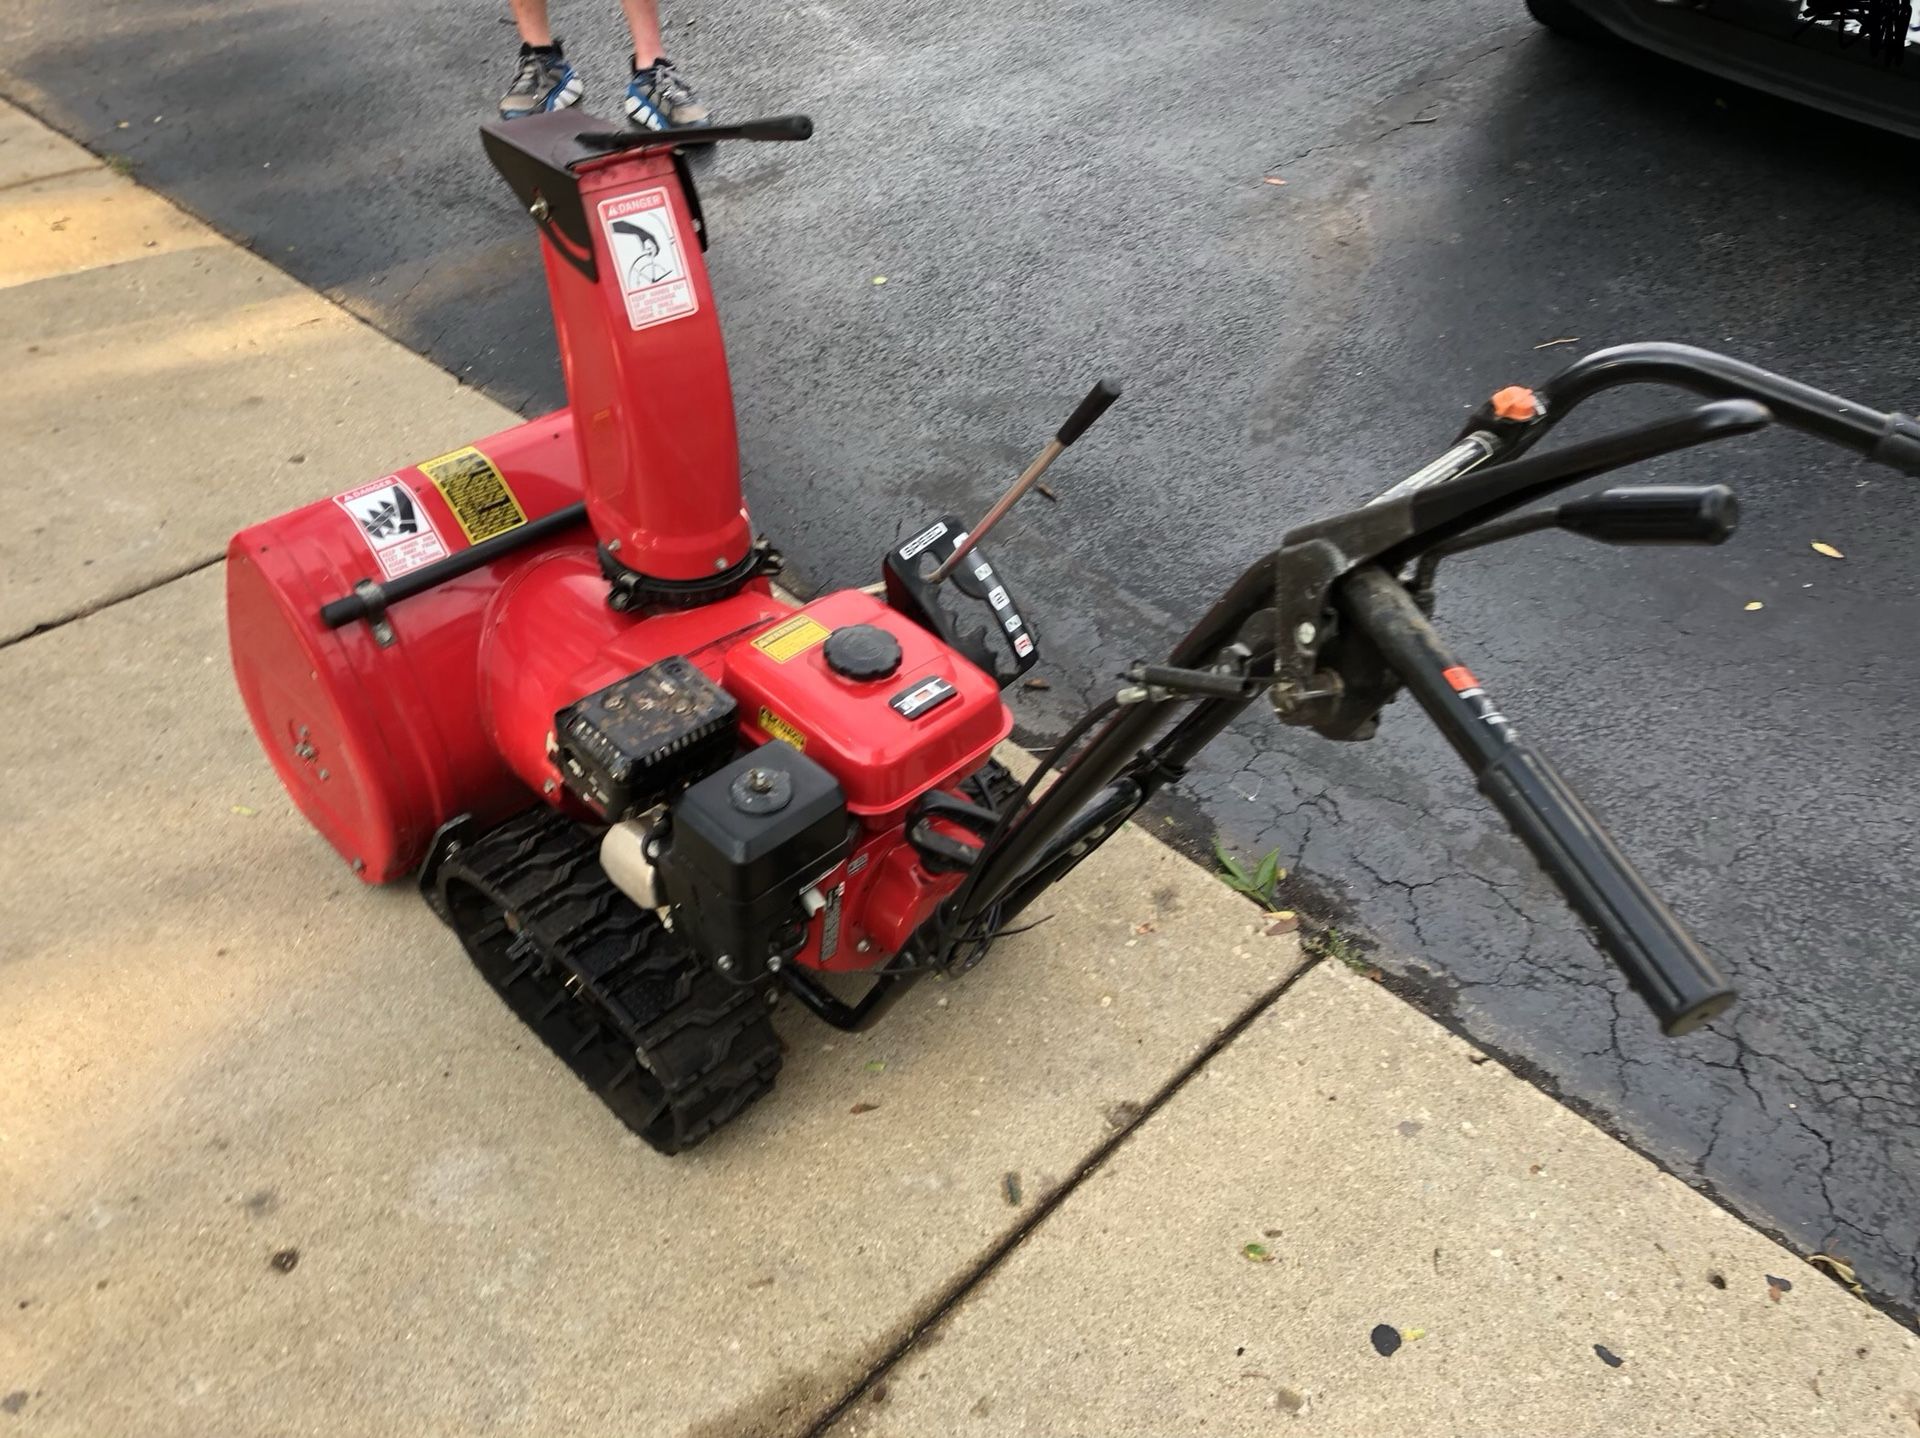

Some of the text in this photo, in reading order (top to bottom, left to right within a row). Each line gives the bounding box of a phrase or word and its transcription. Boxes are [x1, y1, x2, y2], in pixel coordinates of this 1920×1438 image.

[619, 195, 662, 214] DANGER
[351, 479, 392, 497] DANGER
[764, 616, 809, 643] WARNING
